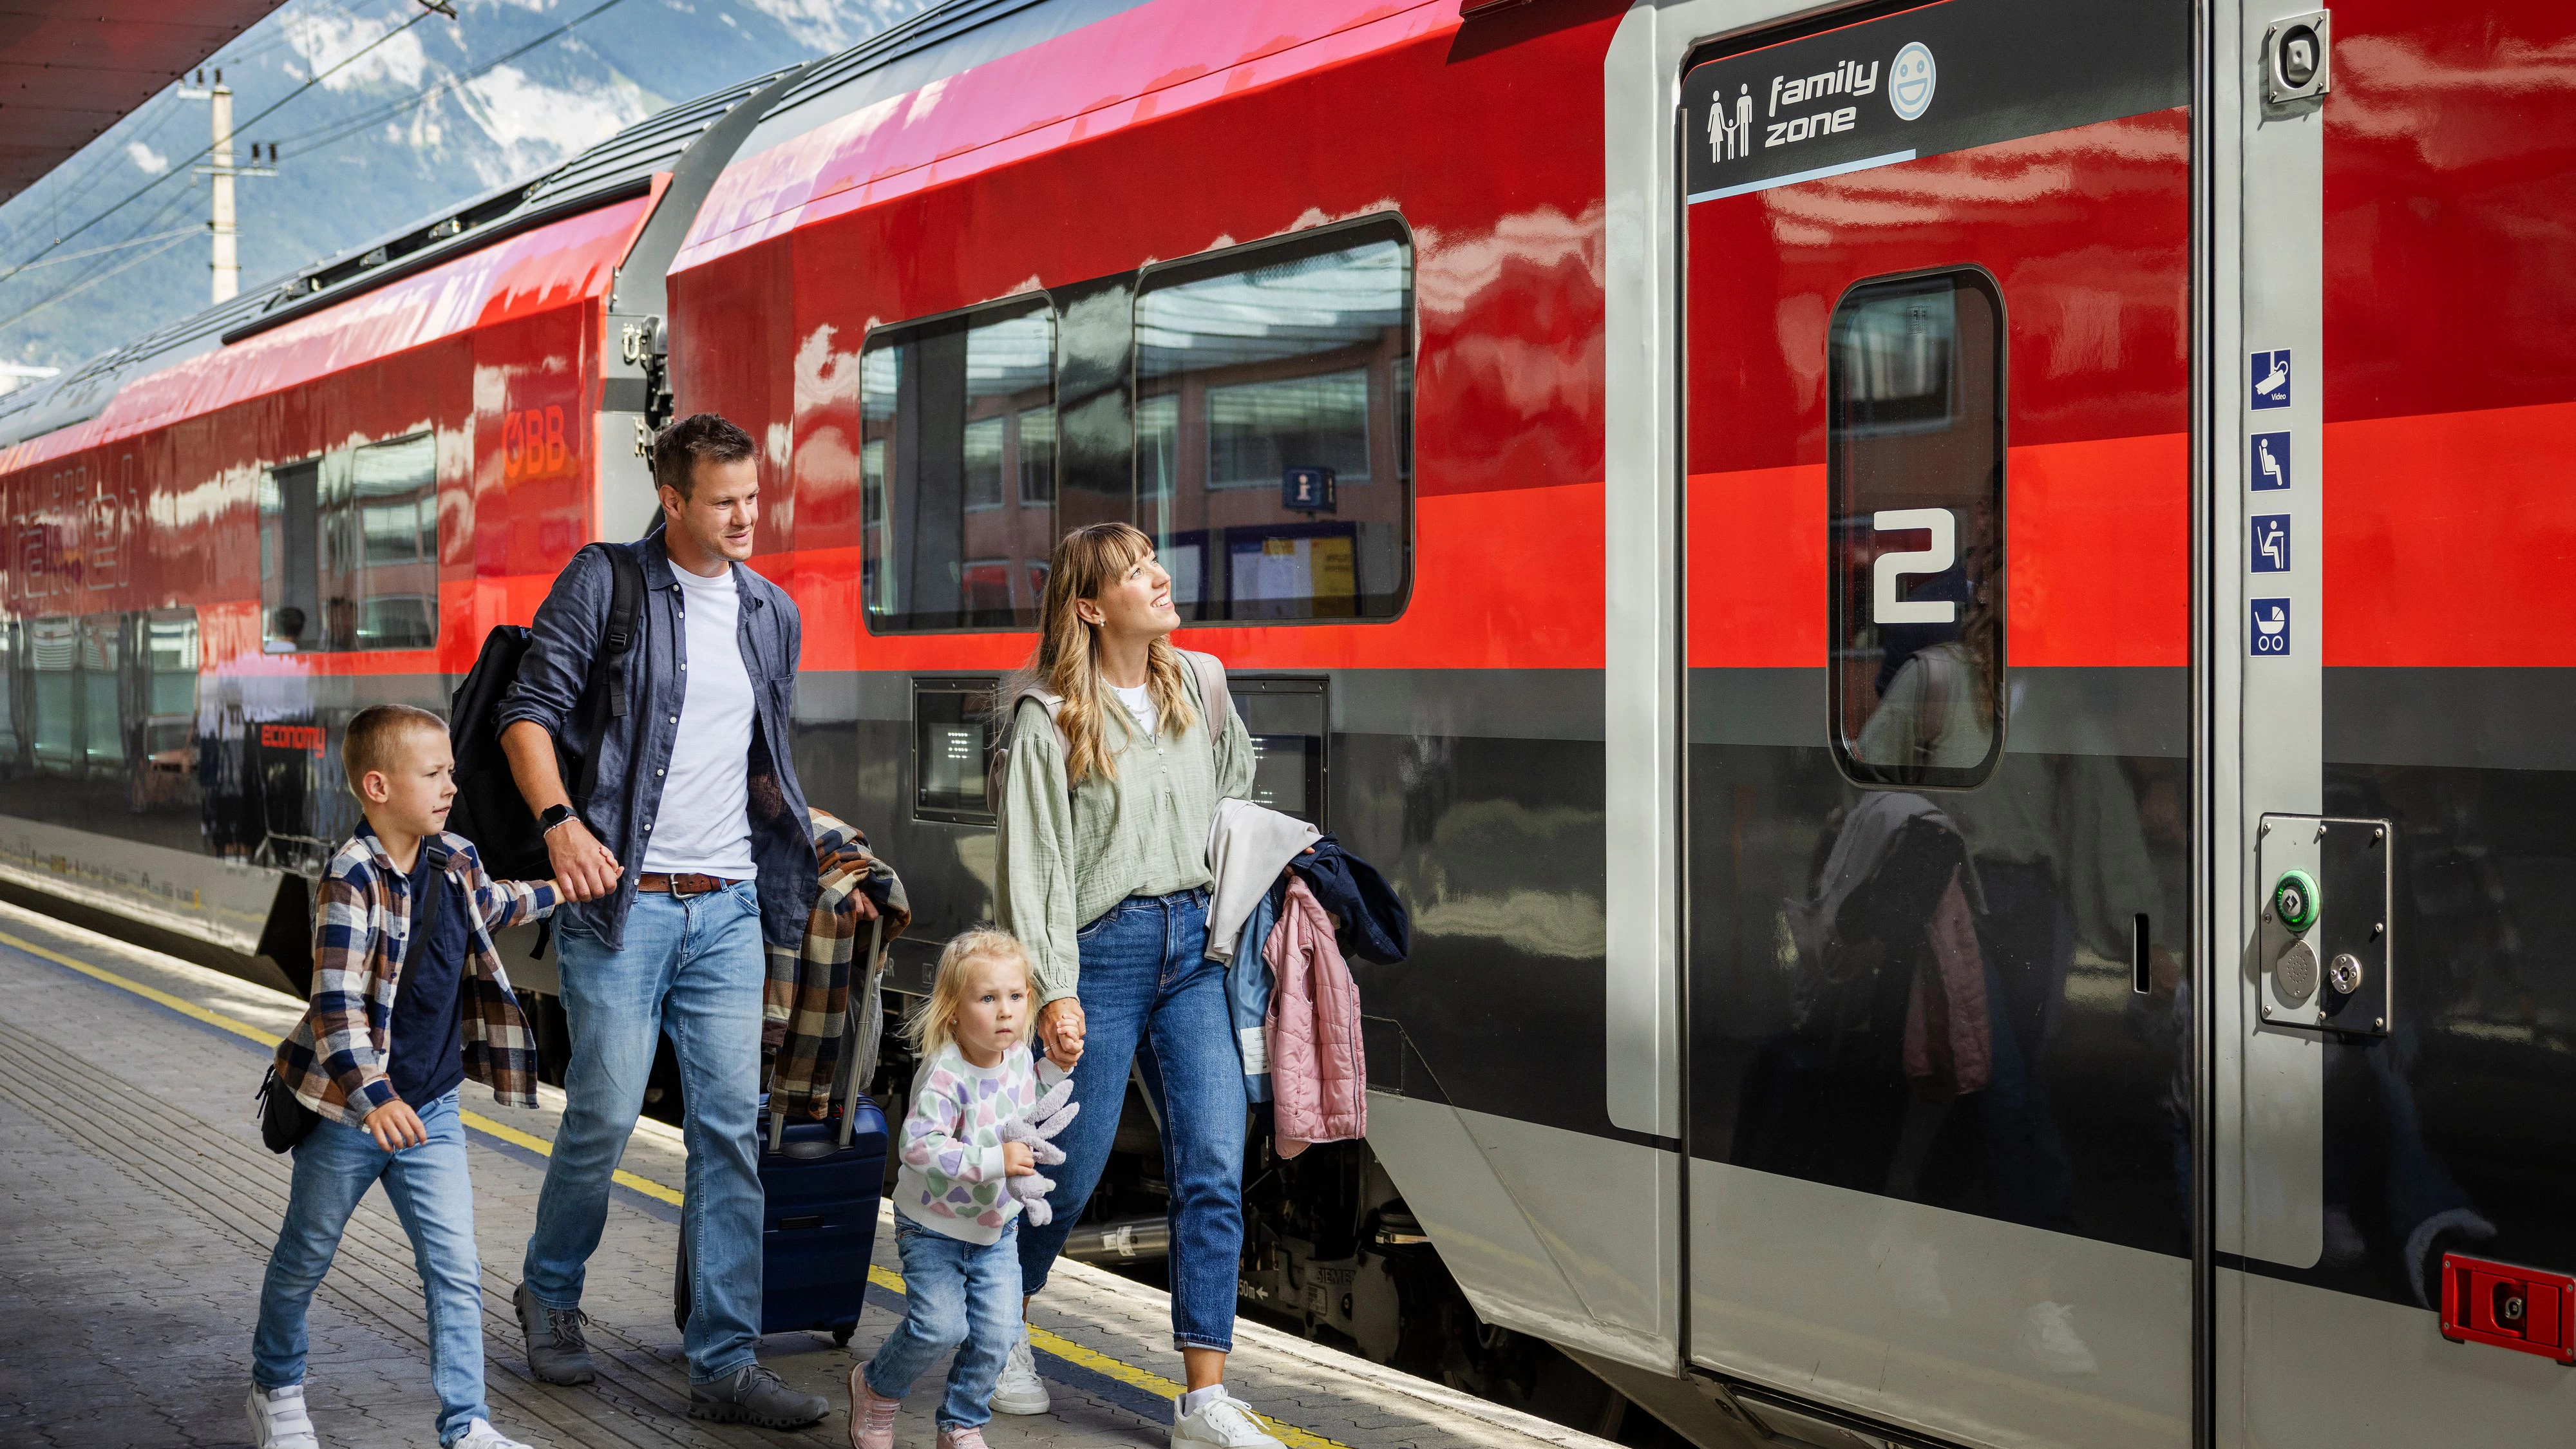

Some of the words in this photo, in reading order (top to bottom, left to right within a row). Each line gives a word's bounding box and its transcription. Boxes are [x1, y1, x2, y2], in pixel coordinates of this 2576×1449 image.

[1768, 60, 1879, 117] family
[1765, 106, 1857, 149] zone
[2271, 392, 2286, 401] Video
[502, 404, 566, 479] ÖBB
[1873, 507, 1955, 624] 2
[261, 723, 326, 758] economy
